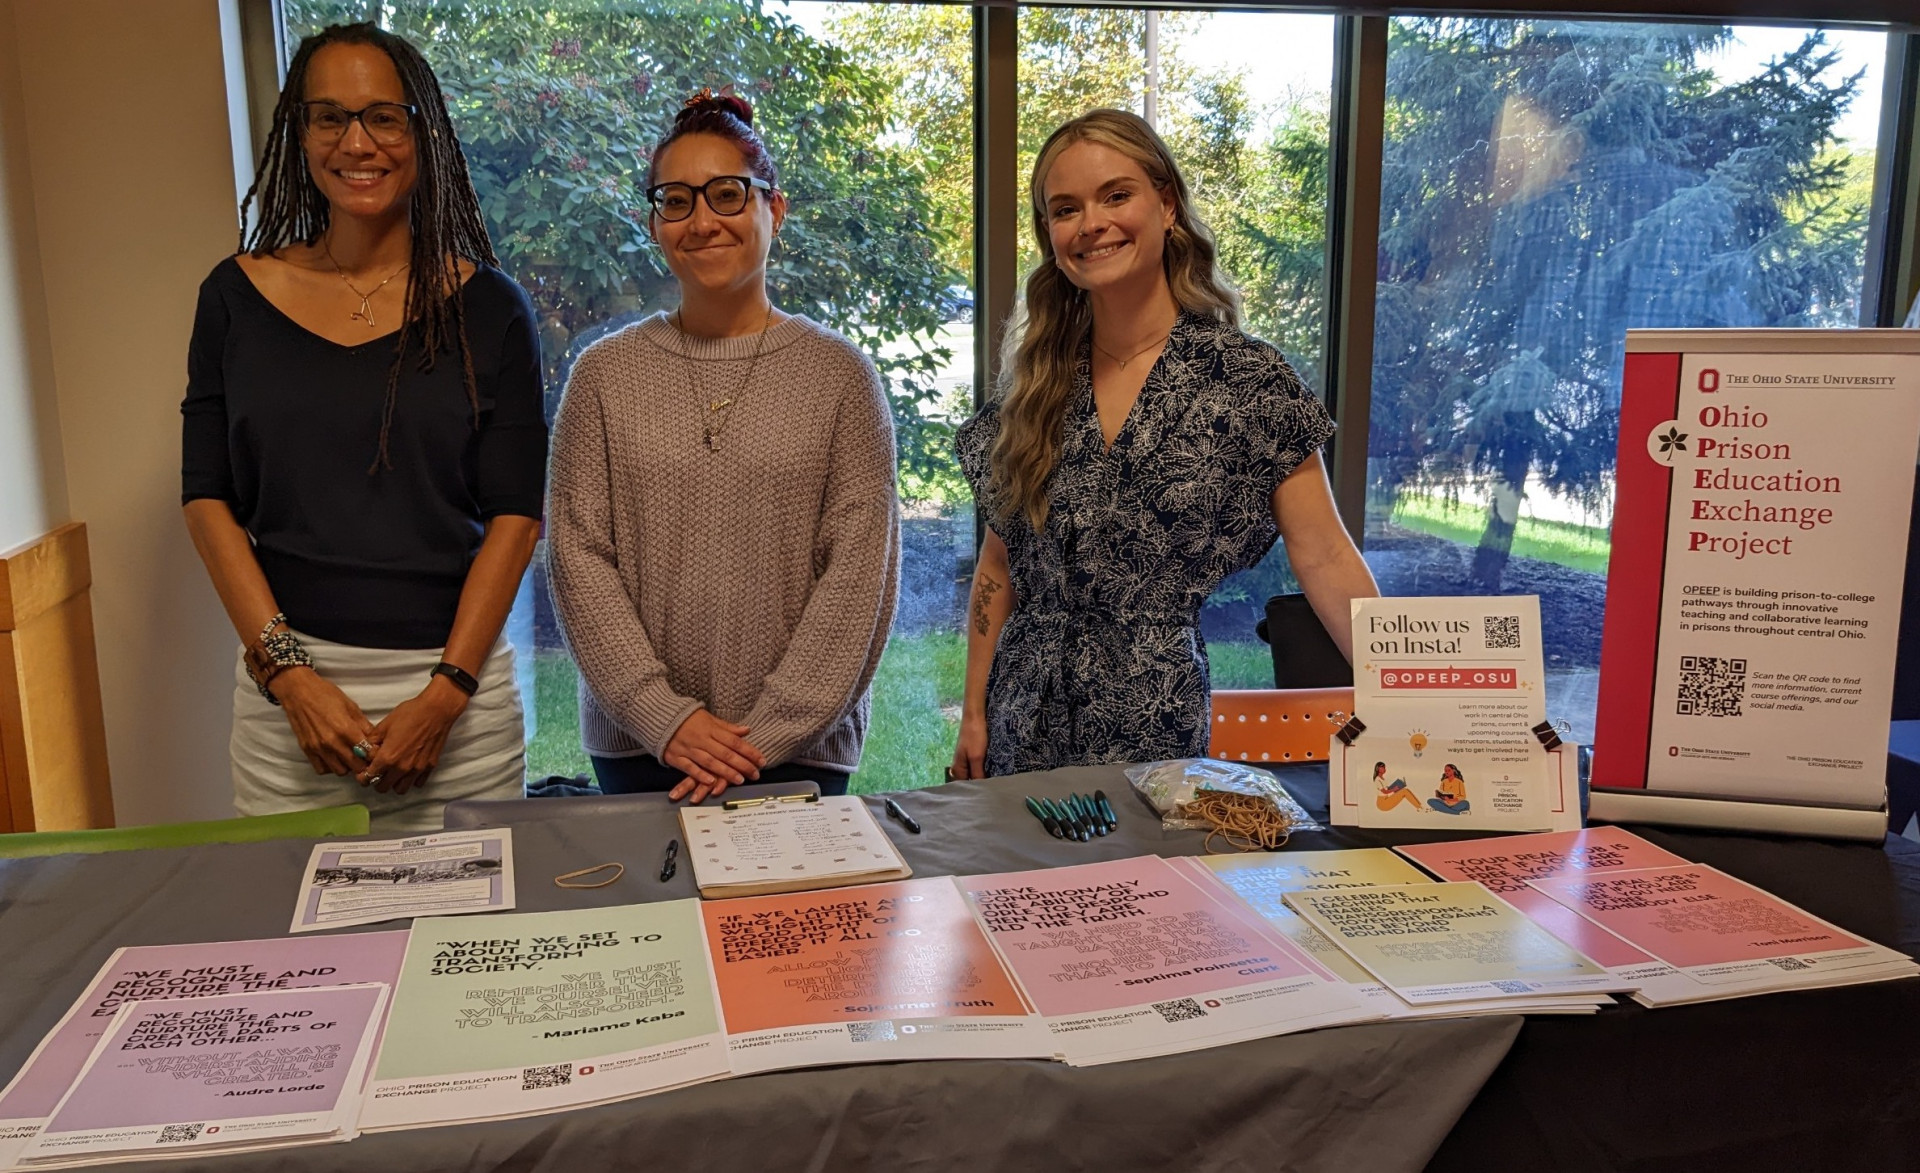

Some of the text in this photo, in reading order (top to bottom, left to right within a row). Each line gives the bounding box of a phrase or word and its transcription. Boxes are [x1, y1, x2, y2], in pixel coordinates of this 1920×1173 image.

[1726, 374, 1896, 385] THE OHIO STATE UNIVERSITY
[1698, 405, 1768, 428] Ohio
[1696, 437, 1792, 460] Prison
[1692, 467, 1841, 492] Education
[1690, 499, 1833, 530] Exchange
[1688, 531, 1792, 560] Project
[1682, 586, 1876, 604] OPEEP is building prison-to-college
[1681, 598, 1838, 613] pathways through innovative
[1370, 614, 1470, 634] Follow us
[1680, 610, 1868, 628] teaching and collaborative learning
[1680, 622, 1866, 639] in prisons throughout central Ohio.
[1370, 636, 1462, 654] on Insta!
[1383, 672, 1511, 686] @OPEEP_OSU
[1752, 672, 1861, 685] Scan the QR code to find
[1776, 682, 1828, 694] information,
[1830, 686, 1862, 696] current
[1782, 692, 1822, 704] offerings,
[1824, 696, 1841, 704] and
[1750, 702, 1805, 712] social media.
[1454, 864, 1508, 873] THAT
[1588, 851, 1624, 860] ARE
[1653, 874, 1683, 882] JOB
[981, 902, 1021, 910] THE
[1030, 893, 1098, 907] ABILITY
[1040, 890, 1170, 913] TO RESPOND
[1310, 896, 1440, 909] TEACHING THAT
[1322, 891, 1409, 902] CELEBRATE
[720, 907, 868, 930] SING LITTLE
[753, 900, 868, 920] WE LAUGH
[1031, 908, 1151, 929] THE TRUTH.
[1038, 902, 1136, 921] THEY ARE
[1316, 905, 1387, 915] ENABLES
[1322, 906, 1464, 921] TRANSGRESSIONS
[1330, 910, 1499, 926] MOVEMENT AGAINST
[721, 912, 874, 936] WE FIGHT THE
[722, 920, 863, 943] GOOD FIGHT
[1340, 919, 1450, 932] AND BEYOND
[1343, 926, 1455, 938] BOUNDARIES.
[433, 934, 662, 958] ABOUT TRYING TO
[436, 931, 617, 948] "WHEN WE SET
[724, 926, 857, 950] FREEDOM, IT
[724, 932, 878, 956] MAKES IT ALL
[1778, 935, 1832, 945] Morrison
[432, 950, 583, 967] TRANSFORM
[726, 947, 805, 963] EASIER.
[183, 964, 254, 977] MUST
[430, 961, 542, 976] SOCIETY,
[561, 960, 681, 983] WE MUST
[1122, 955, 1270, 987] Septima Poinsette
[1237, 964, 1280, 976] Clark
[112, 967, 337, 990] RECOGNIZE AND
[466, 969, 681, 1000] REMEMBER THAT
[106, 979, 289, 998] NURTURE THE
[484, 976, 683, 1007] WE OURSELVES
[460, 984, 684, 1018] WILL ALSO NEED
[137, 1010, 314, 1028] RECOGNIZE AND
[191, 1007, 249, 1018] MUST
[132, 1020, 275, 1036] NURTURE THE
[455, 1017, 493, 1029] TO
[544, 1010, 685, 1039] Mariame Kaba
[126, 1021, 338, 1043] CREATIVE PARTS OF
[120, 1040, 182, 1051] EACH
[408, 1074, 517, 1090] PRISON EDUCATION
[223, 1084, 326, 1098] Audre Lorde
[375, 1083, 490, 1099] EXCHANGE PROJECT
